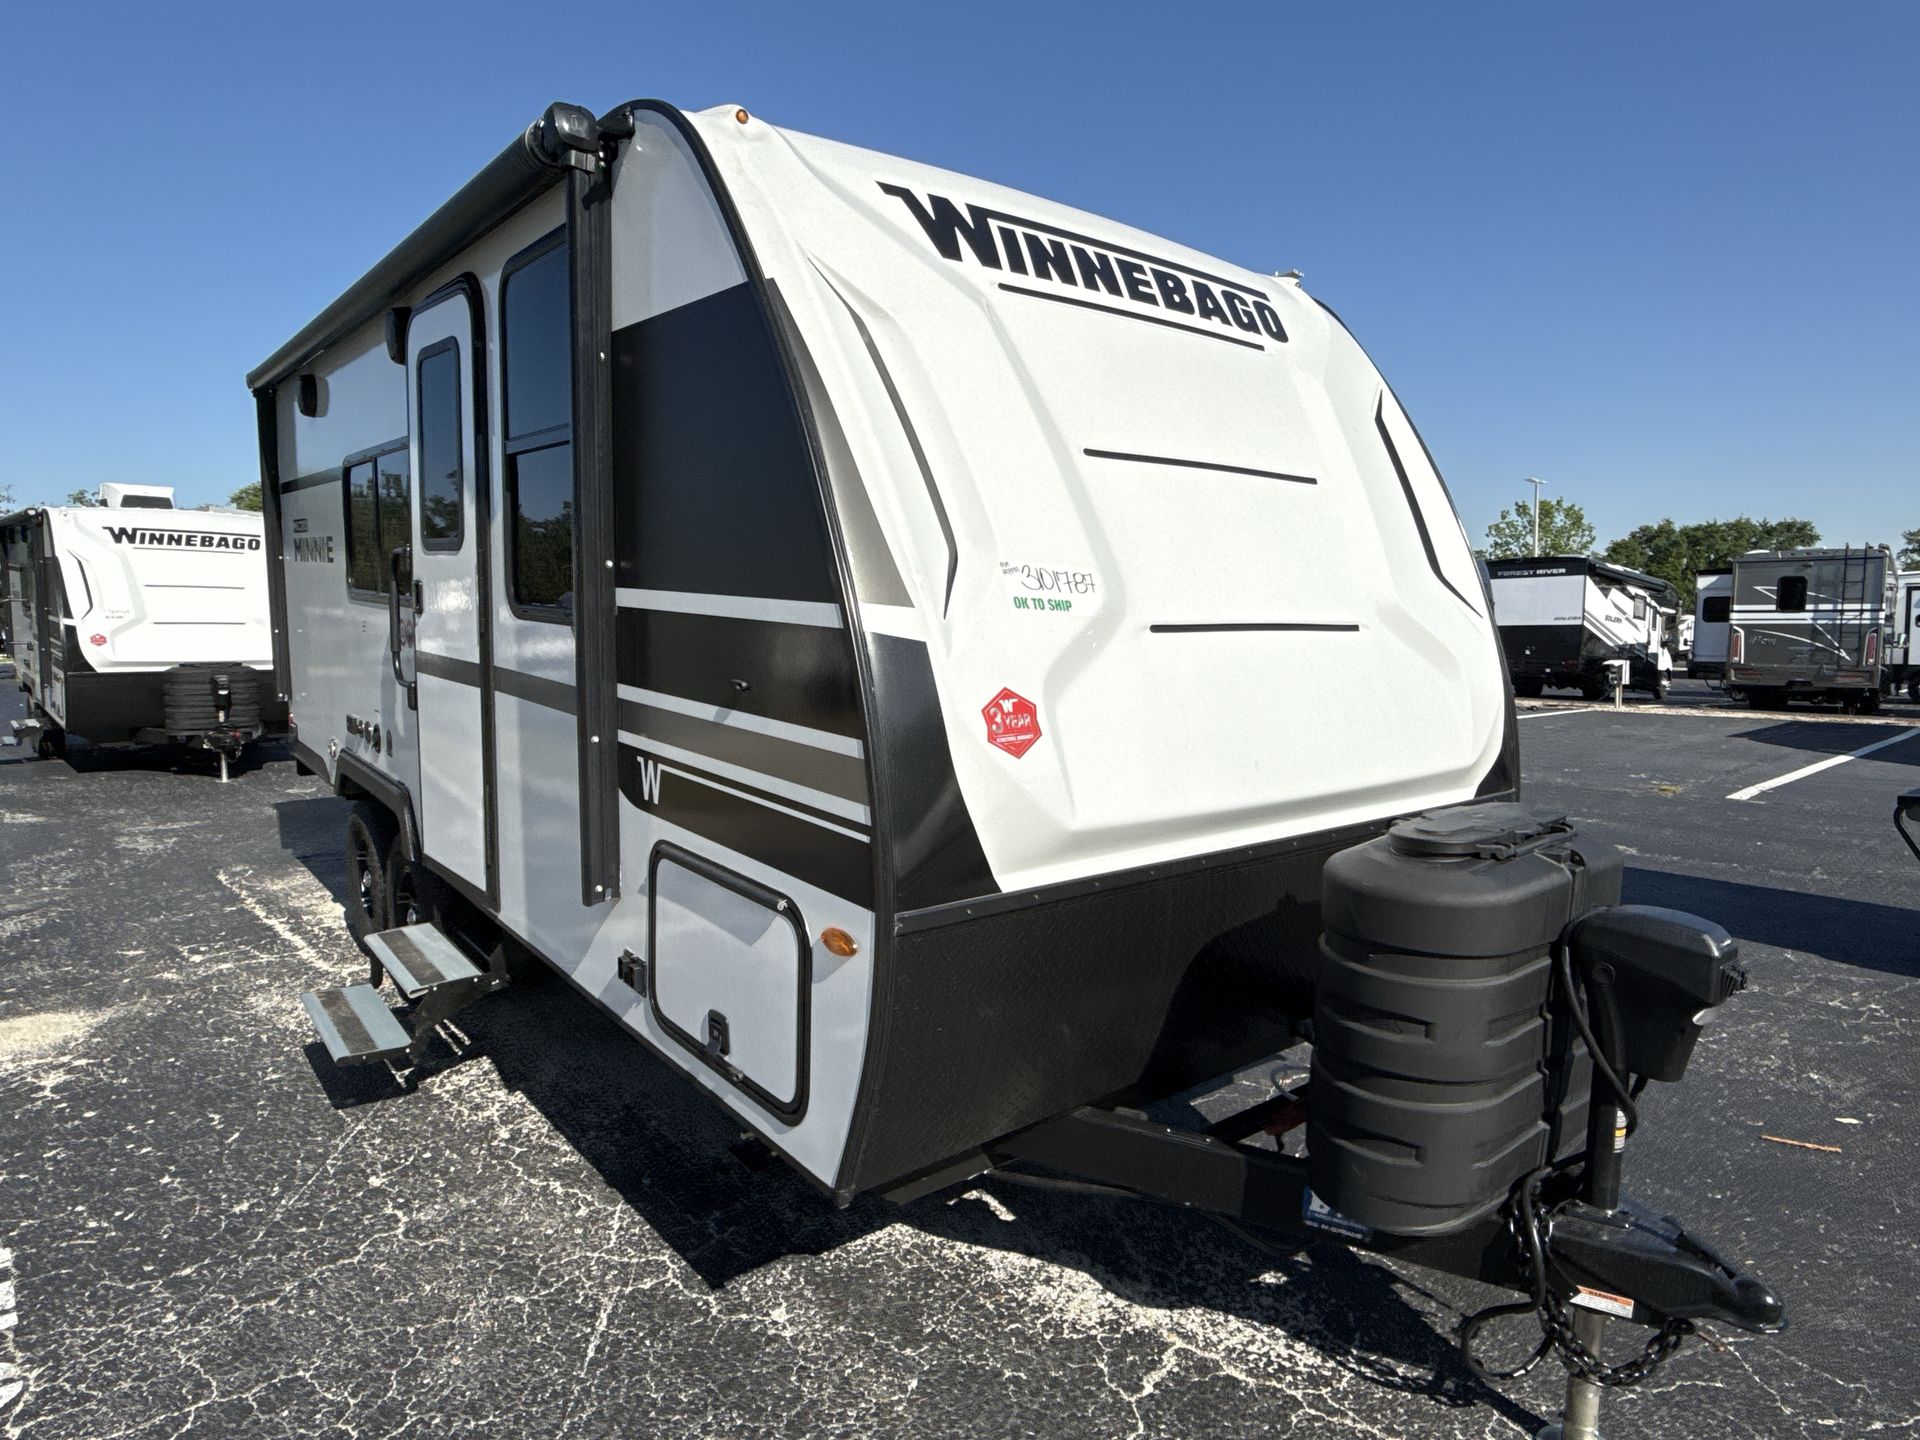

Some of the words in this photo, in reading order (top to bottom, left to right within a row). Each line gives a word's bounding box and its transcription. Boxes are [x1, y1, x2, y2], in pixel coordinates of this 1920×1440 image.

[874, 181, 1289, 343] WINNEBAGO
[102, 526, 261, 550] WINNEBAGO
[293, 536, 334, 563] MINNIE
[1497, 569, 1535, 577] FOREST
[1013, 596, 1030, 609] OK
[1031, 597, 1045, 611] TO
[1047, 598, 1072, 612] SHIP
[989, 707, 1003, 734] 3
[1003, 713, 1032, 729] YEAR
[1588, 1291, 1618, 1301] WARNING
